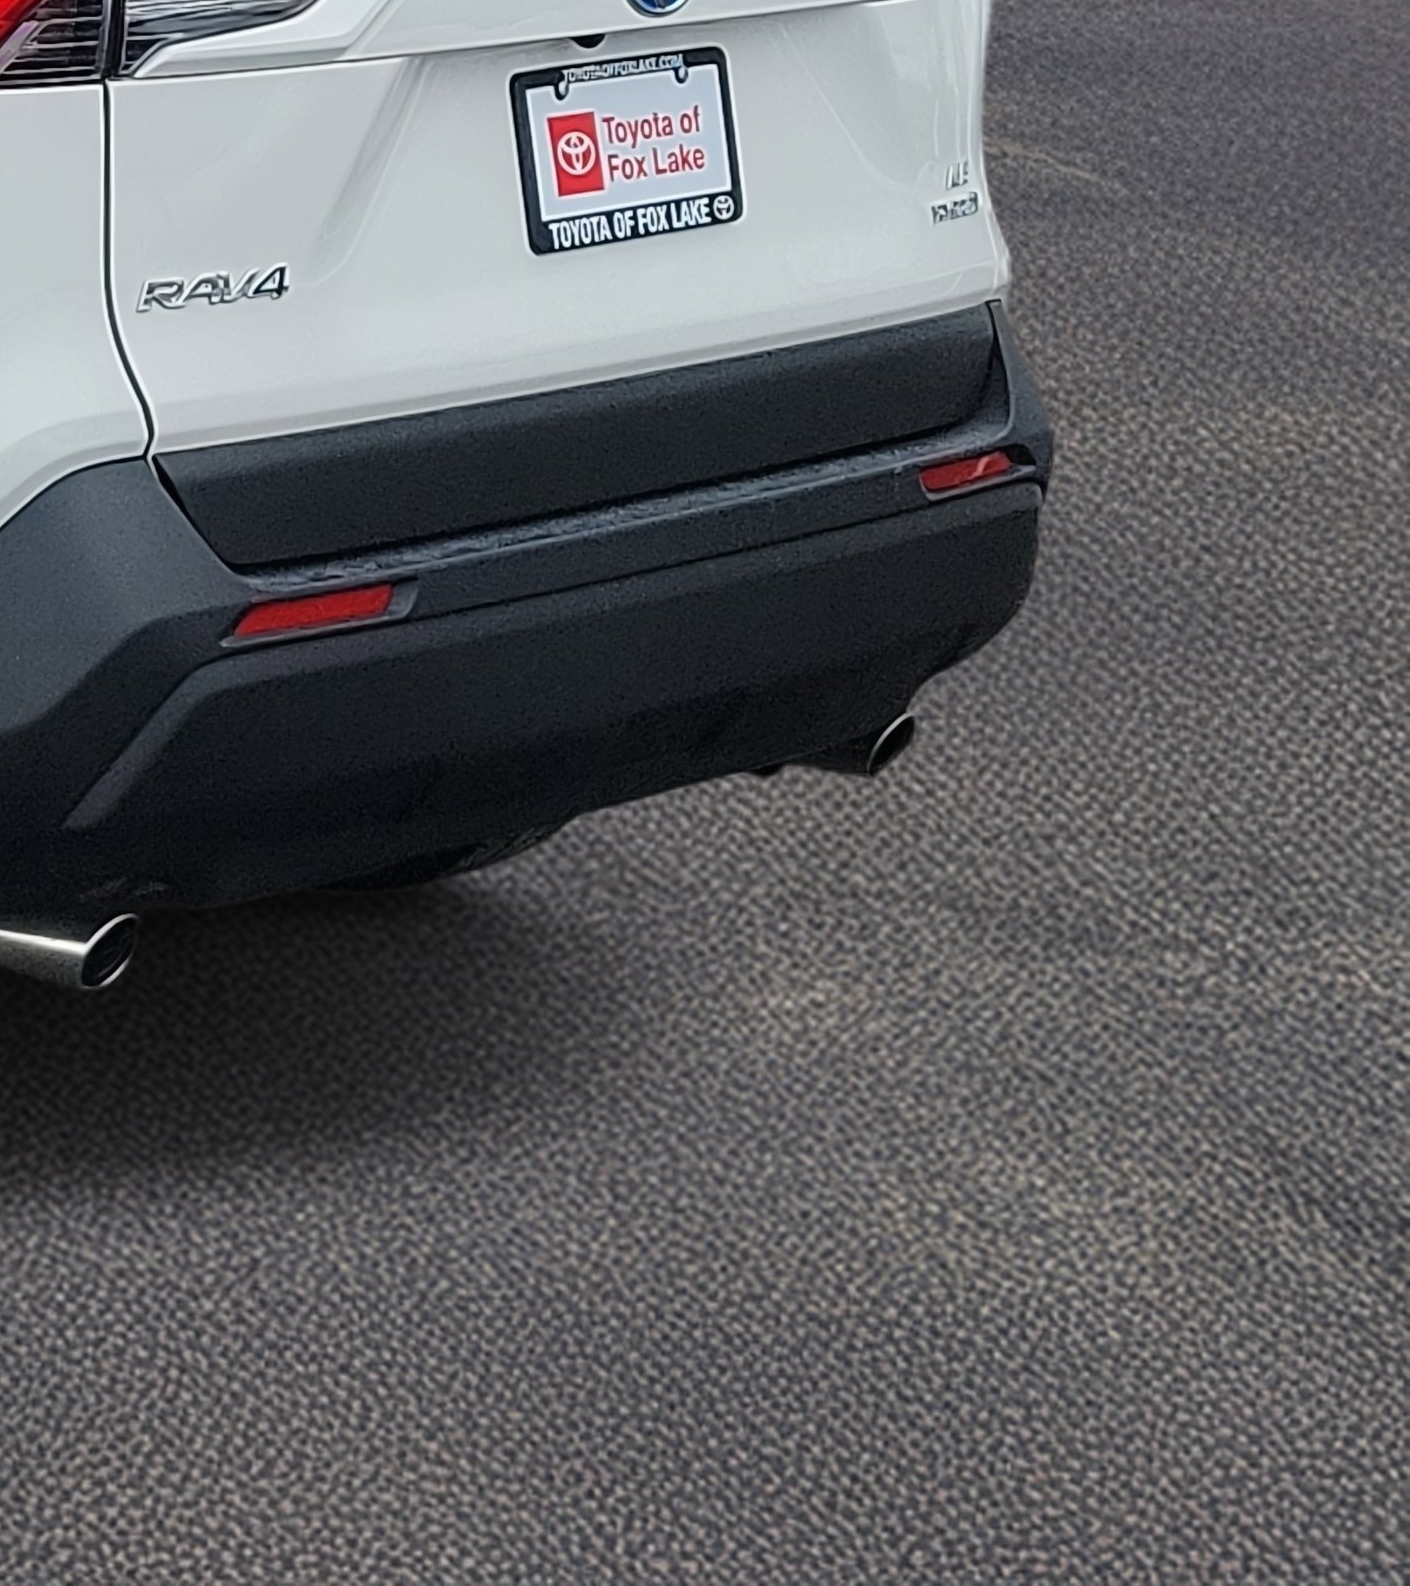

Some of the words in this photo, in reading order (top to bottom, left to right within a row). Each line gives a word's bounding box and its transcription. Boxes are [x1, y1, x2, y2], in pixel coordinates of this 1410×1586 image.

[601, 112, 674, 149] Toyota
[679, 104, 701, 135] of
[607, 154, 648, 182] Fox
[652, 143, 705, 175] Lake
[548, 215, 614, 250] TOYOTA
[613, 210, 635, 240] OF
[636, 202, 669, 235] FOX
[670, 197, 712, 229] LAKE
[136, 262, 289, 313] RAV4
